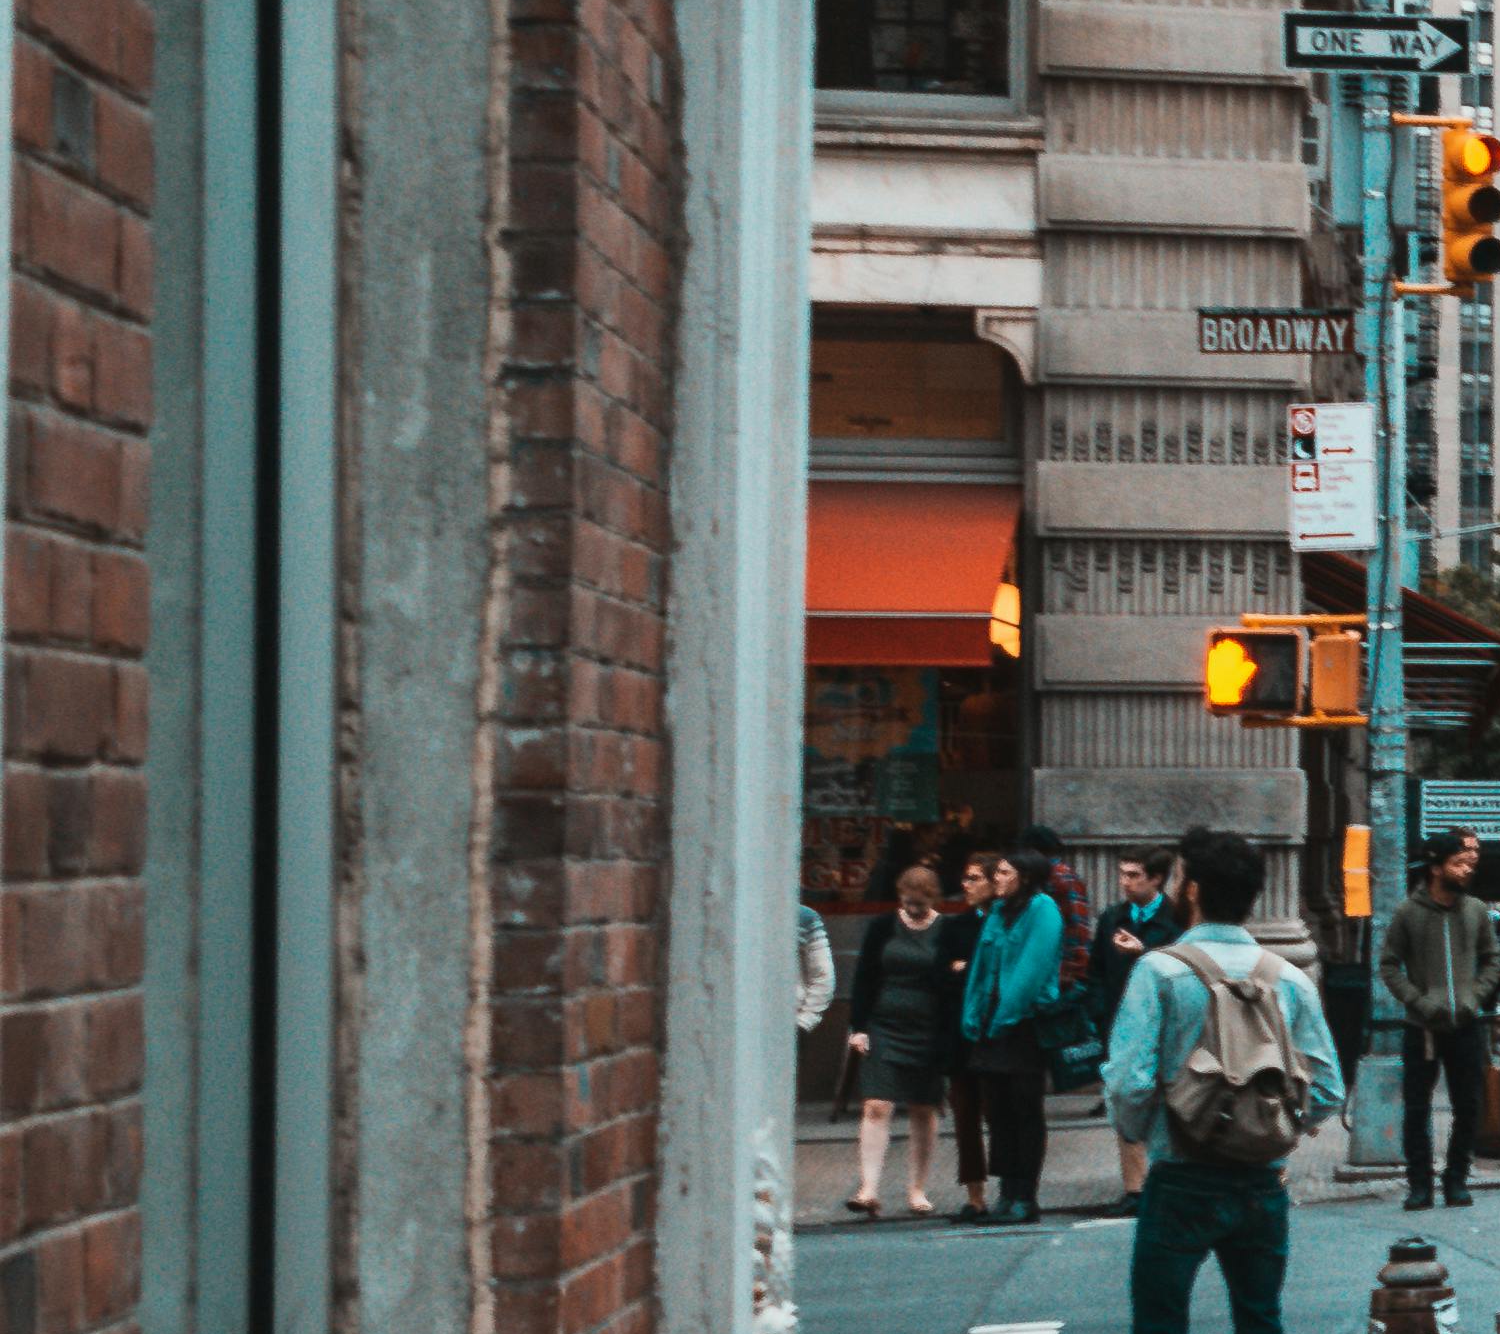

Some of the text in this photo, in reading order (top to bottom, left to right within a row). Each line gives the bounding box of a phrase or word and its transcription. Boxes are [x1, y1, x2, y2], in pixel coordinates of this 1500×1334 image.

[1310, 29, 1442, 57] ONE WAY
[1202, 317, 1350, 352] BROADWAY
